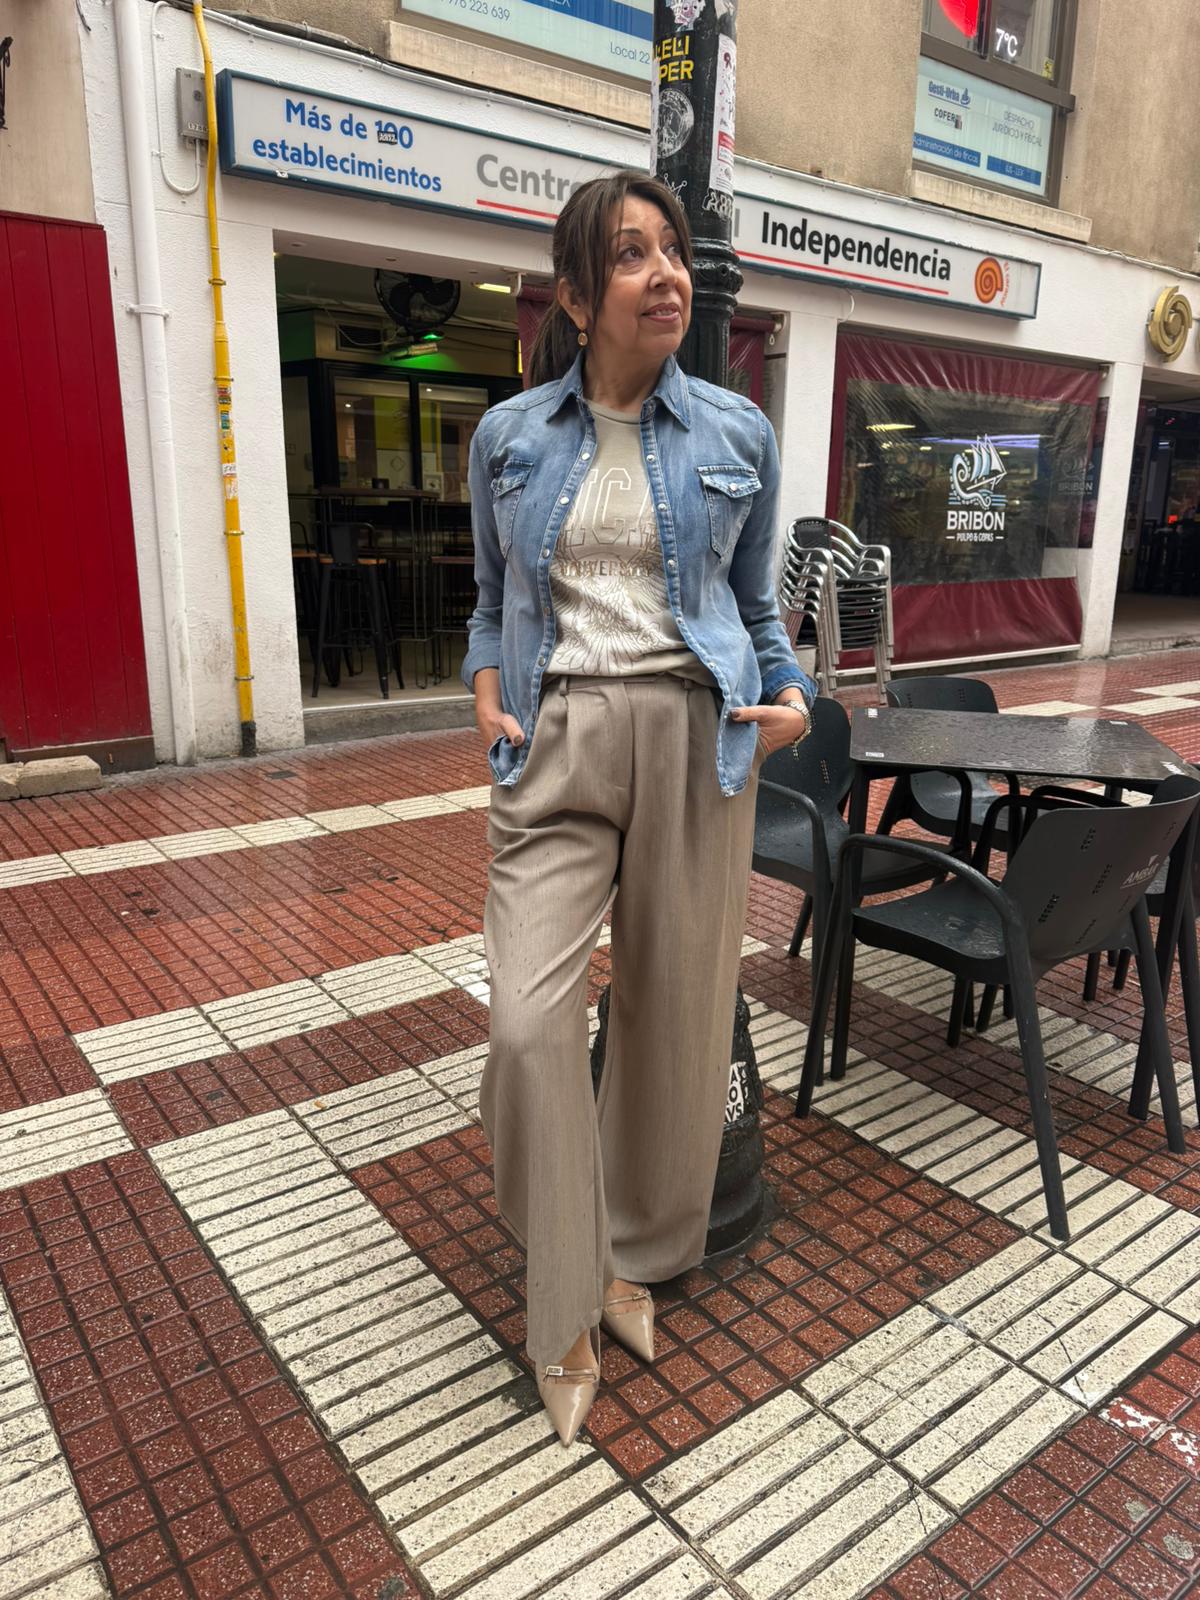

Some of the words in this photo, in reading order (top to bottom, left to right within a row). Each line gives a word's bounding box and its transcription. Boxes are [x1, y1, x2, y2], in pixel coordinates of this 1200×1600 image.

[491, 5, 510, 21] 639
[610, 41, 637, 61] Local
[285, 98, 332, 131] Más
[340, 113, 368, 139] de
[253, 138, 442, 192] establecimientos
[761, 211, 951, 281] Independencia
[946, 510, 1006, 531] BRIBON
[956, 532, 974, 542] PULPO
[979, 532, 995, 542] COPAS
